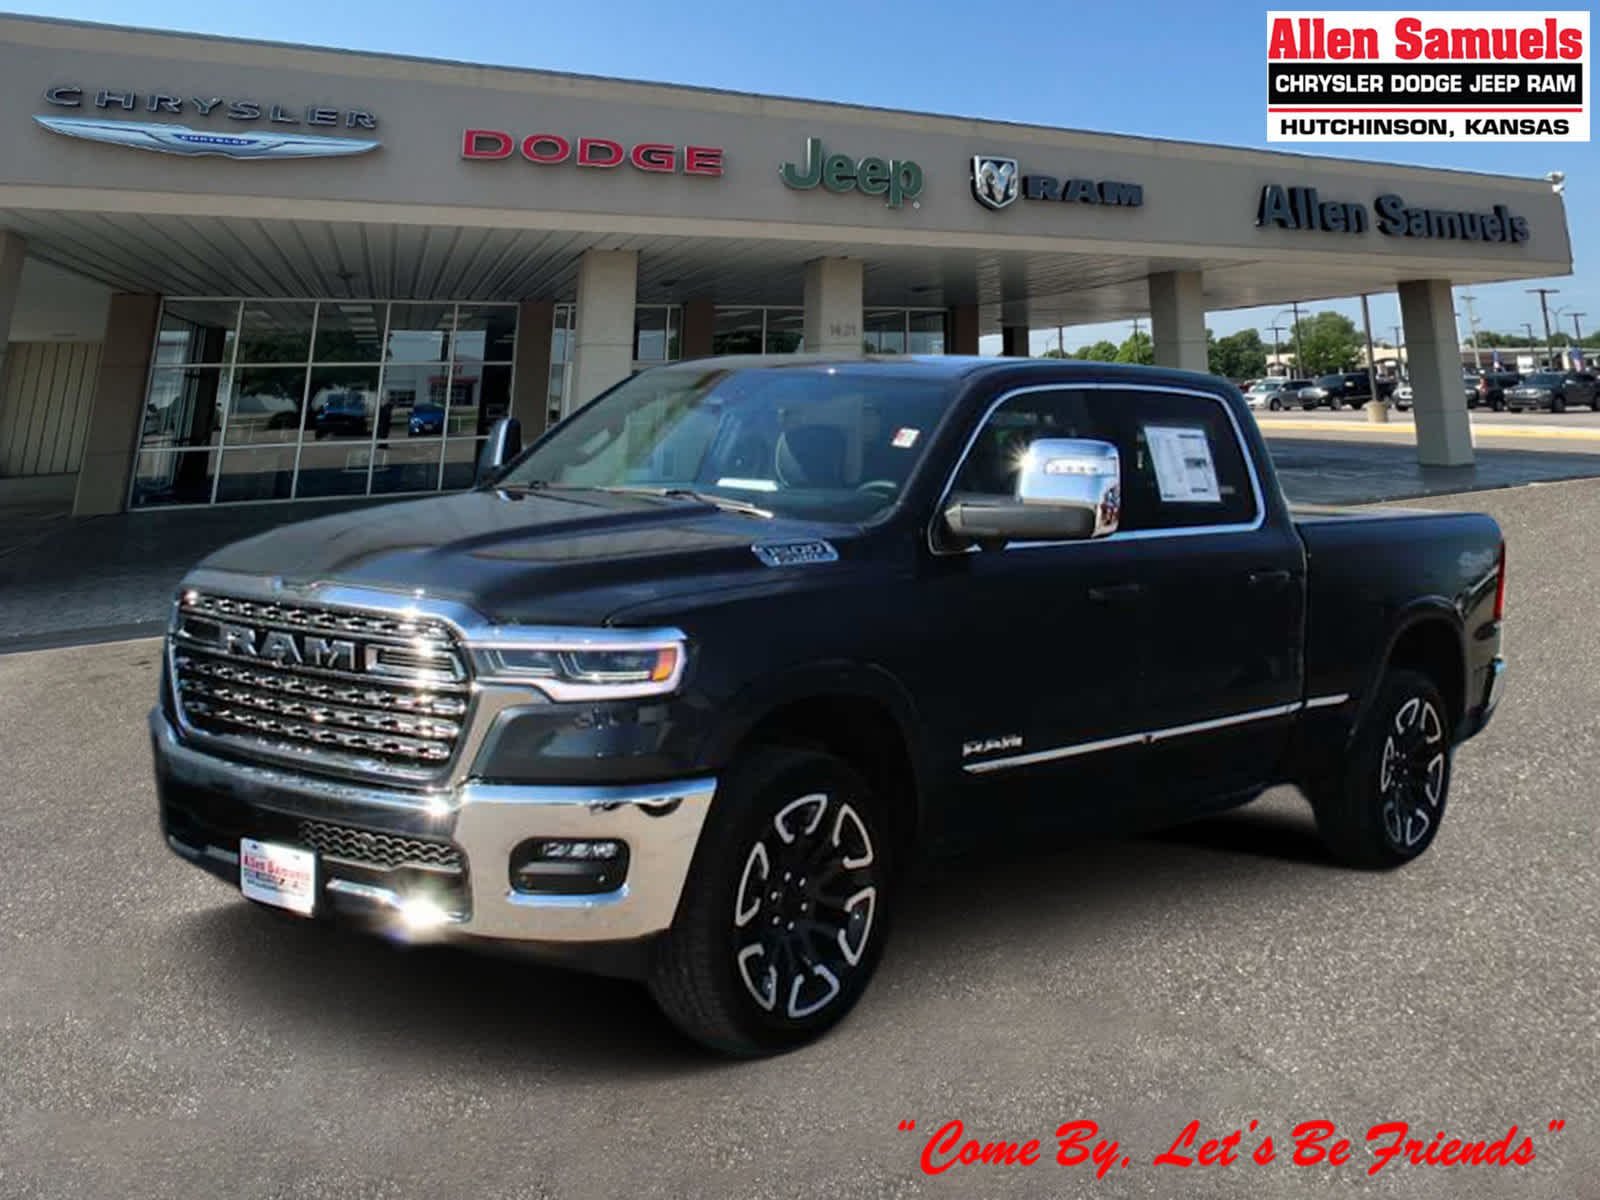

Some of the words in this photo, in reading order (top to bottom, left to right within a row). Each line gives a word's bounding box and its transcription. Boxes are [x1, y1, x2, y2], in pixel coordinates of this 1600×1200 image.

[44, 86, 377, 129] CHRYSLER
[462, 128, 724, 177] DODGE
[779, 137, 923, 209] Jeep
[1023, 175, 1144, 207] RAM
[1255, 184, 1369, 233] Allen
[1374, 195, 1531, 243] Samuels
[220, 624, 356, 670] RAM
